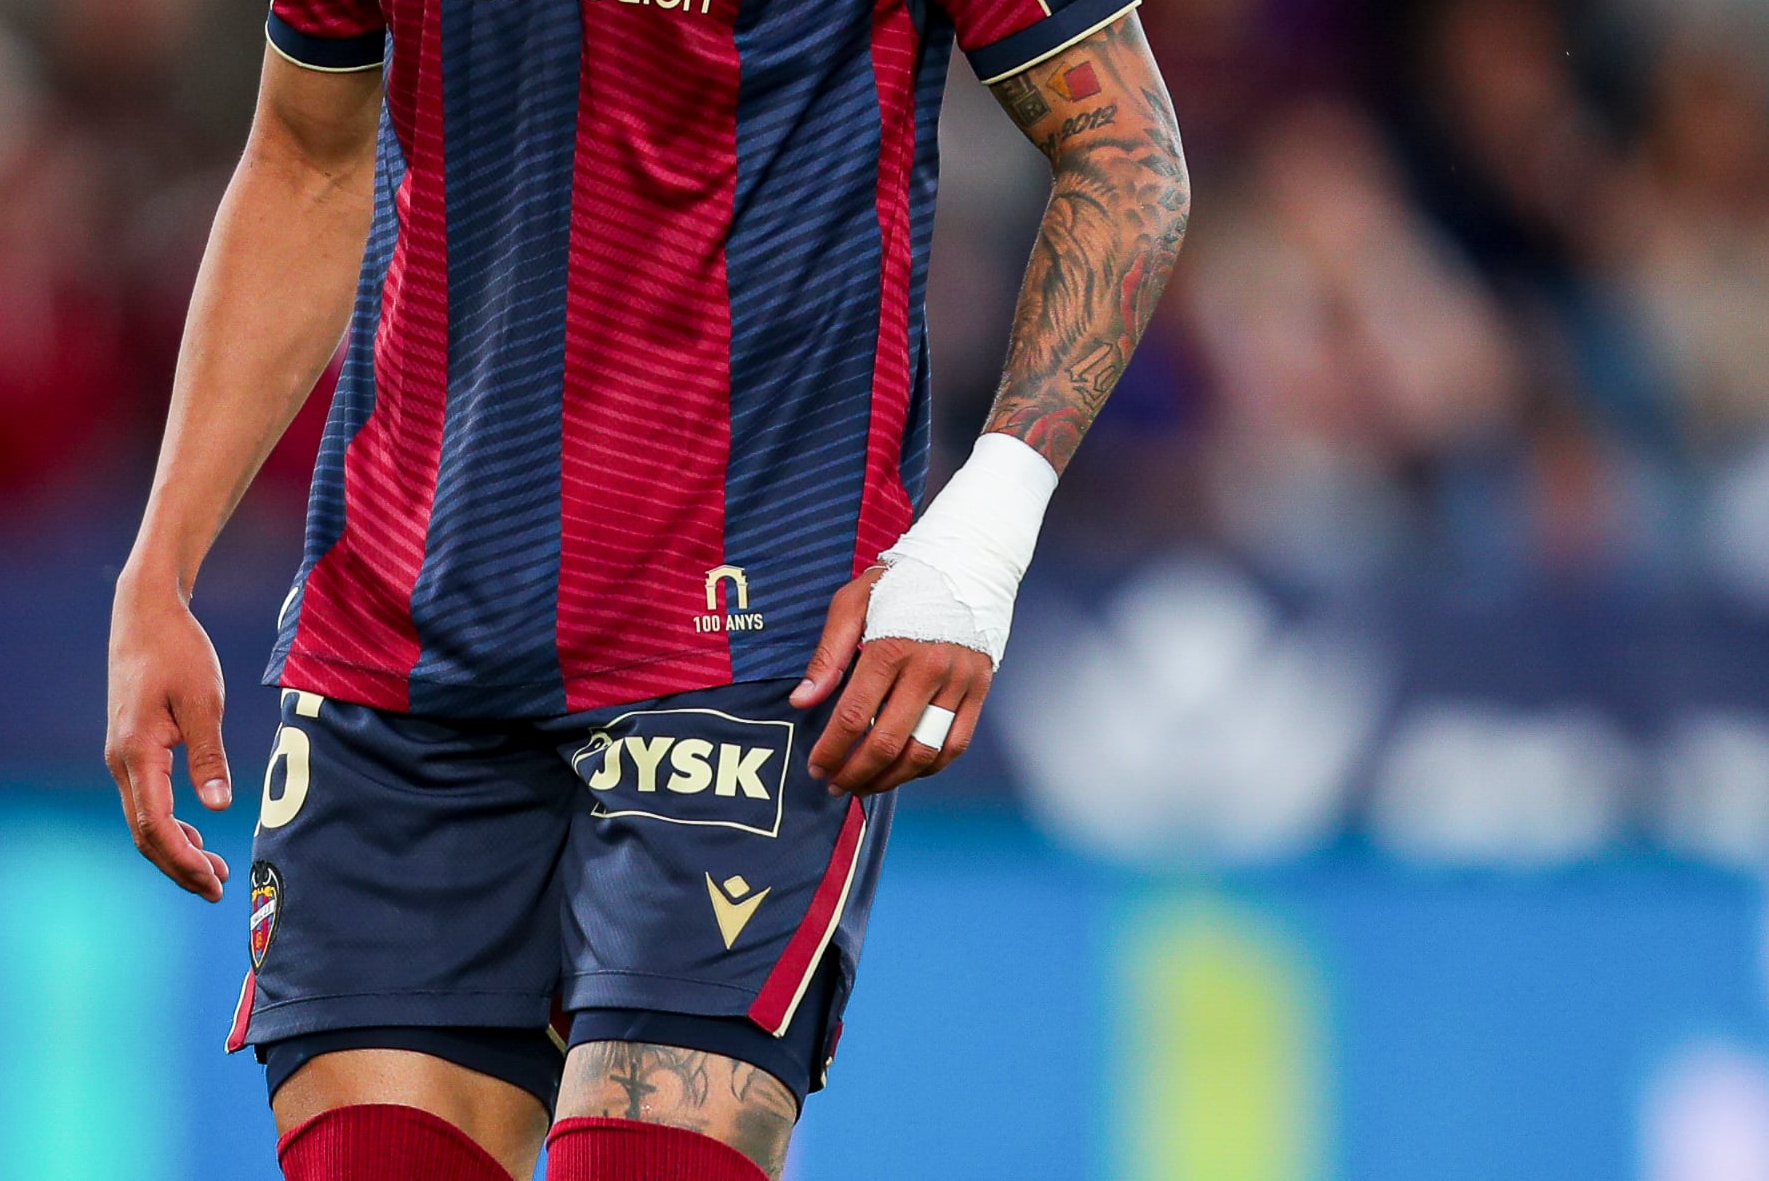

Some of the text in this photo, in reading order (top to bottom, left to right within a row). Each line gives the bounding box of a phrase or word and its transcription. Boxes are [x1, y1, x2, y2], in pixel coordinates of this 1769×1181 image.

[693, 613, 764, 633] 100 ANYS
[588, 736, 775, 800] JYSK
